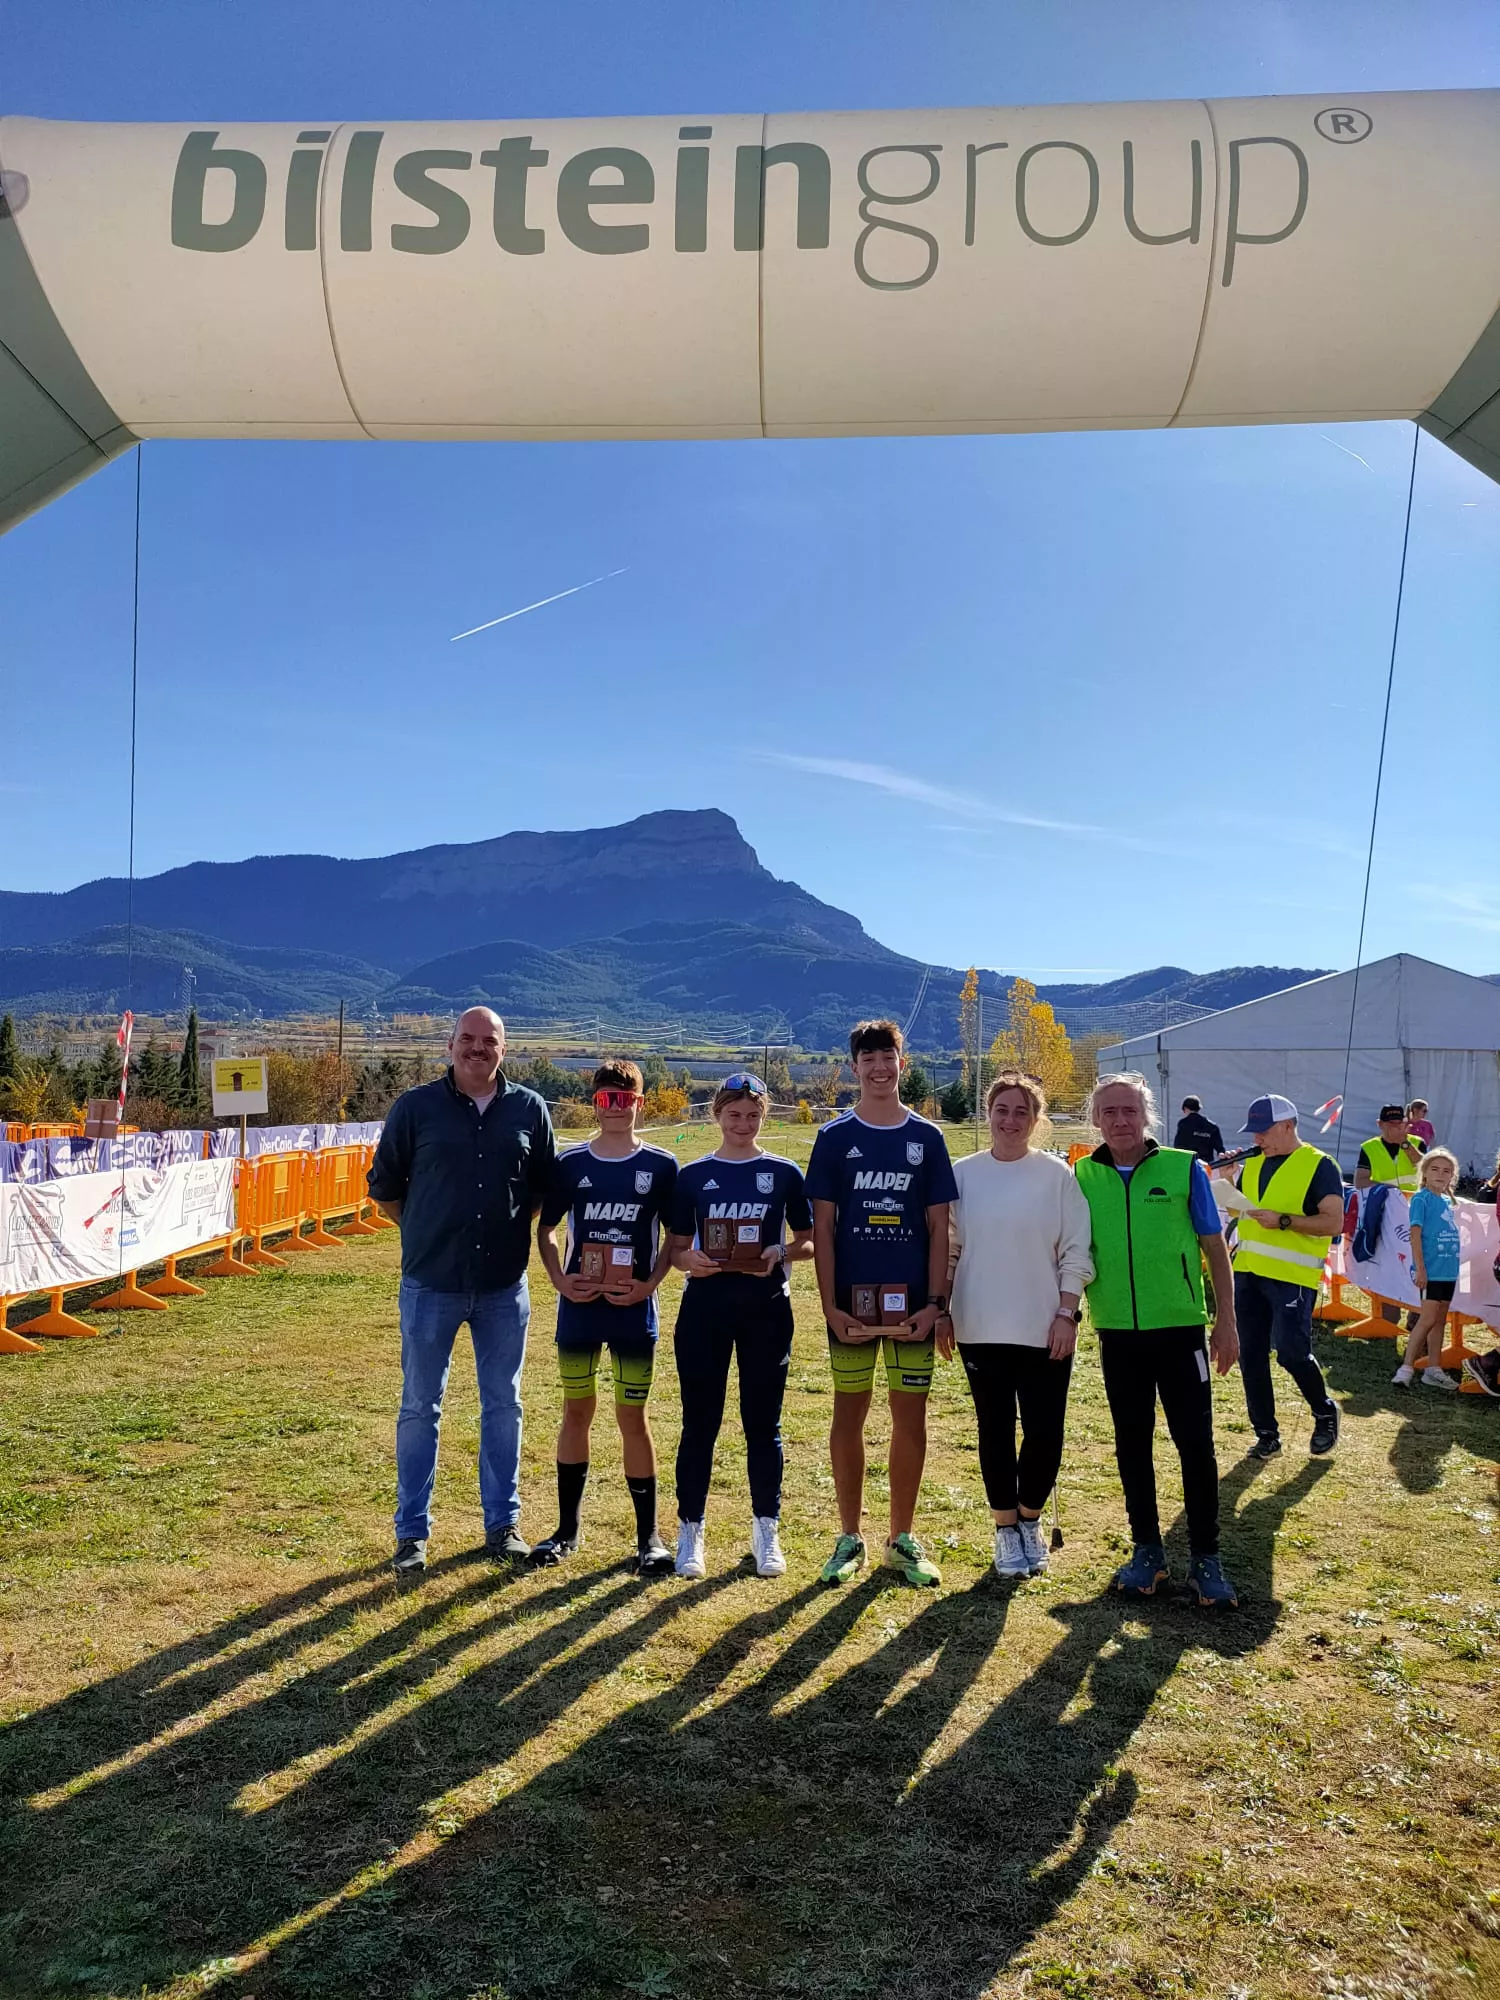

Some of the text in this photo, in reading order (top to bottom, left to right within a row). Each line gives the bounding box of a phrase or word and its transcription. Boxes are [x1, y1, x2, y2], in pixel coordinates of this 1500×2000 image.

[853, 1171, 912, 1191] MAPEI
[584, 1202, 642, 1221] MAPEI
[708, 1202, 770, 1221] MAPEI
[853, 1226, 913, 1236] PRAVIA
